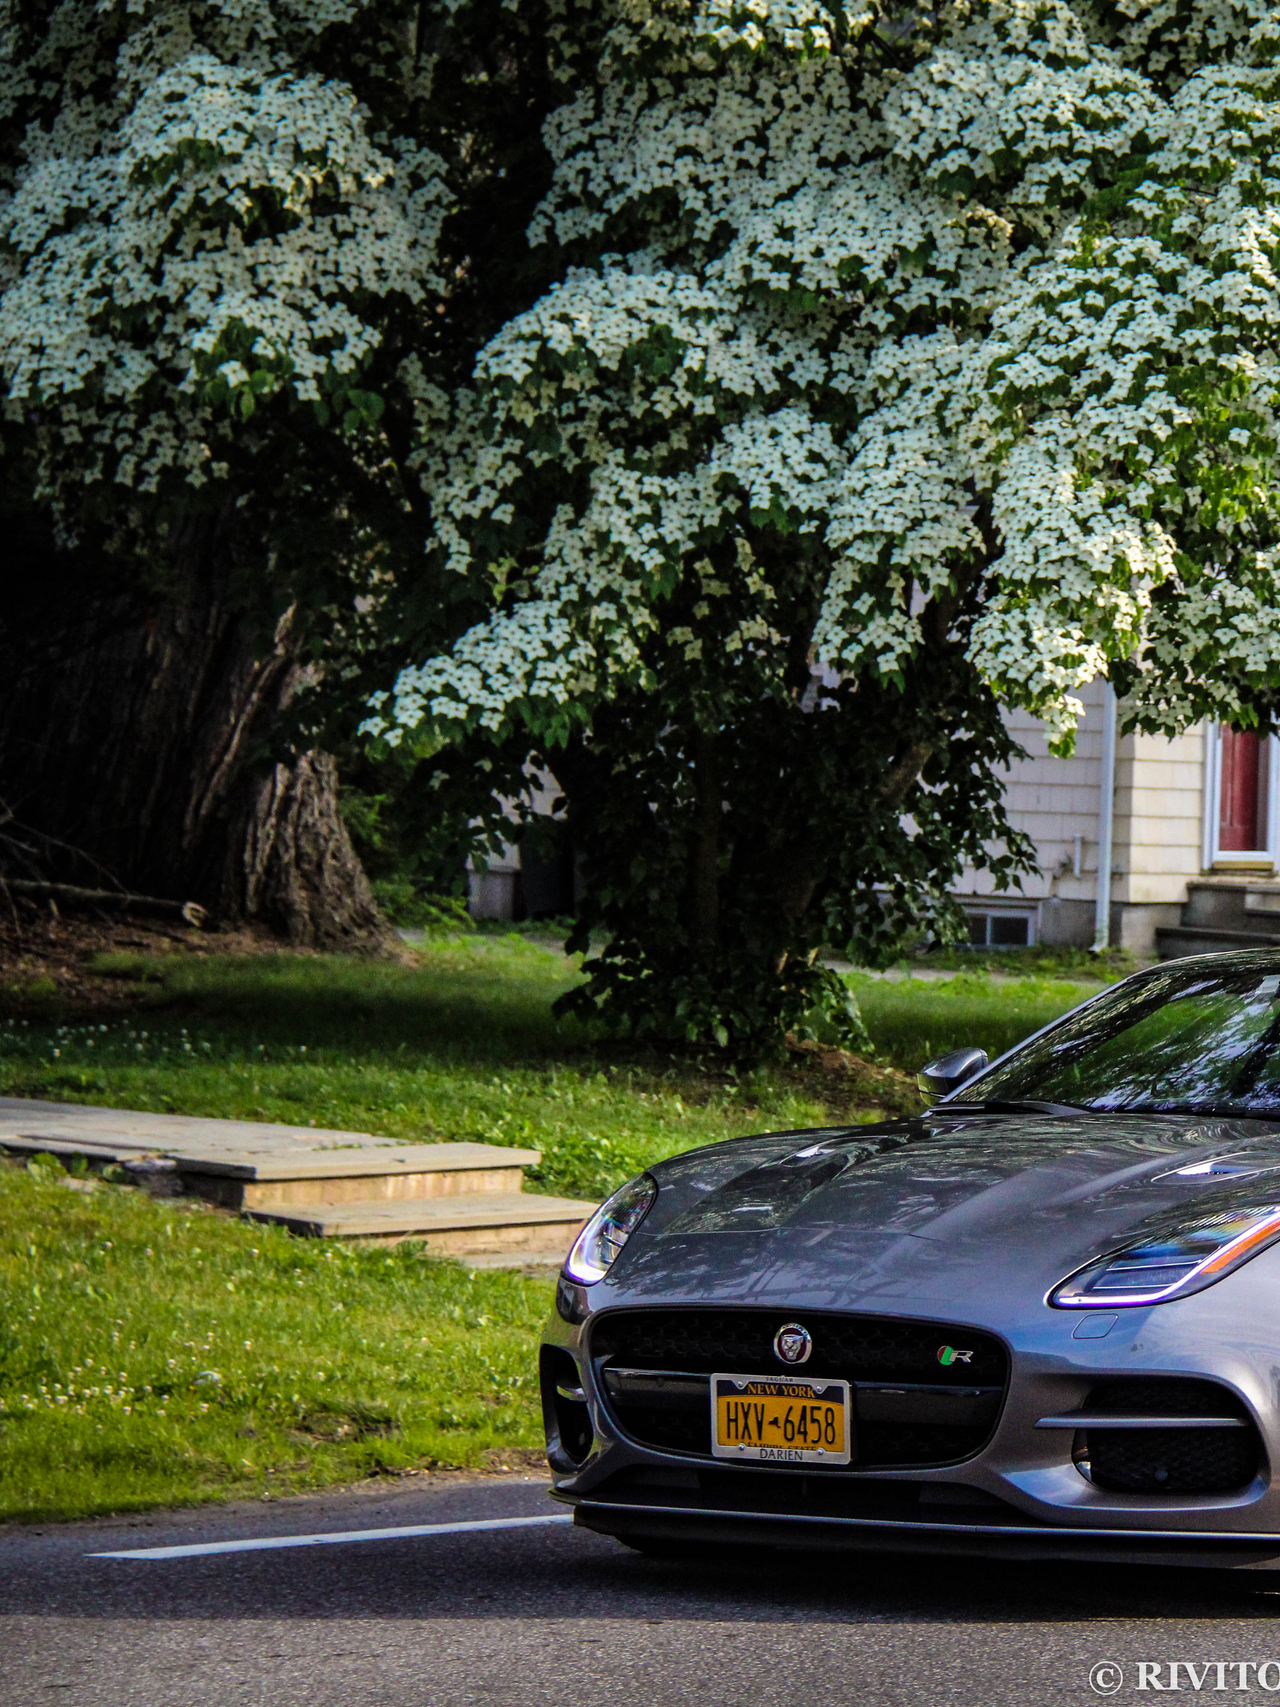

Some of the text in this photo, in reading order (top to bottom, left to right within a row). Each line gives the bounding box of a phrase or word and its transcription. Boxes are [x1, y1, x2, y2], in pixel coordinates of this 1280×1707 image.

[948, 1350, 974, 1363] R
[747, 1383, 816, 1399] NEW YORK
[726, 1401, 836, 1445] HXV 6458
[760, 1448, 804, 1461] DARIEN
